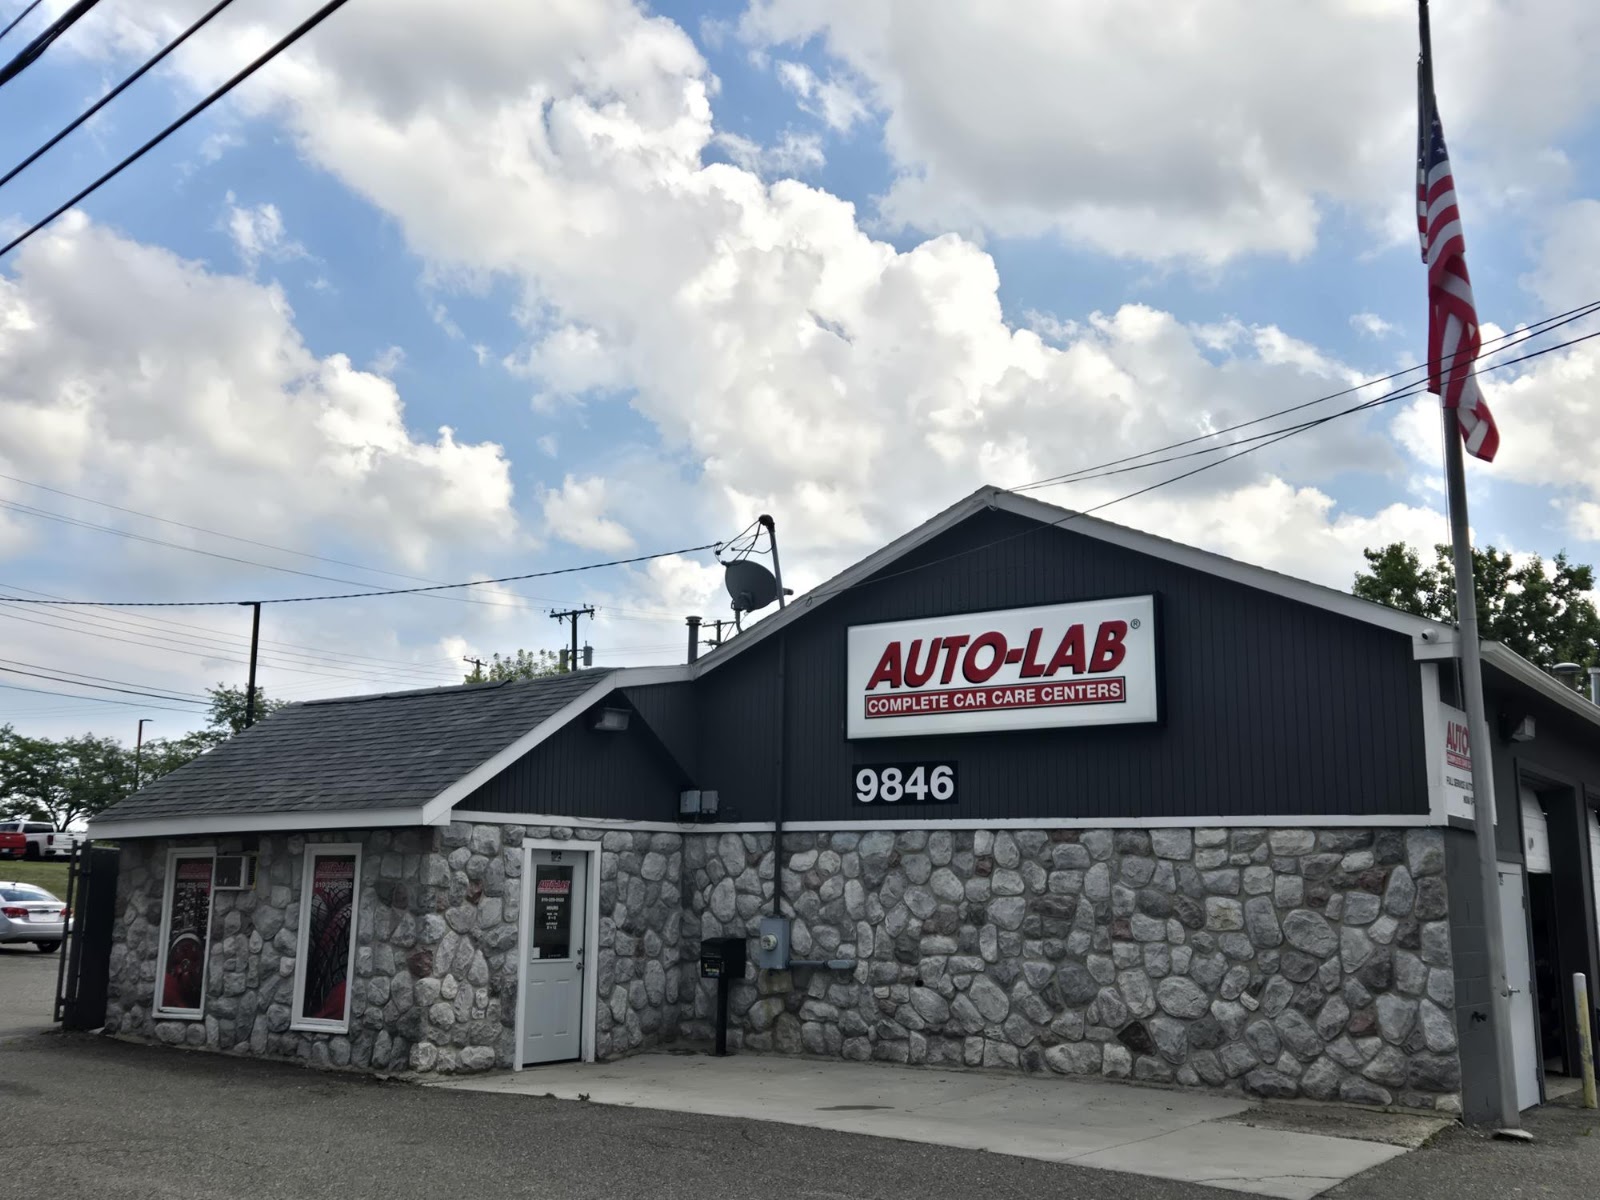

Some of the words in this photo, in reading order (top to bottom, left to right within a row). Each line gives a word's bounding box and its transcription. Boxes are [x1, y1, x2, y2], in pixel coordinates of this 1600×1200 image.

[865, 619, 1128, 691] AUTO-LAB
[868, 694, 949, 714] COMPLETE
[953, 691, 987, 708] CAR
[992, 689, 1036, 706] CARE
[1041, 682, 1121, 701] CENTERS
[856, 764, 955, 803] 9846
